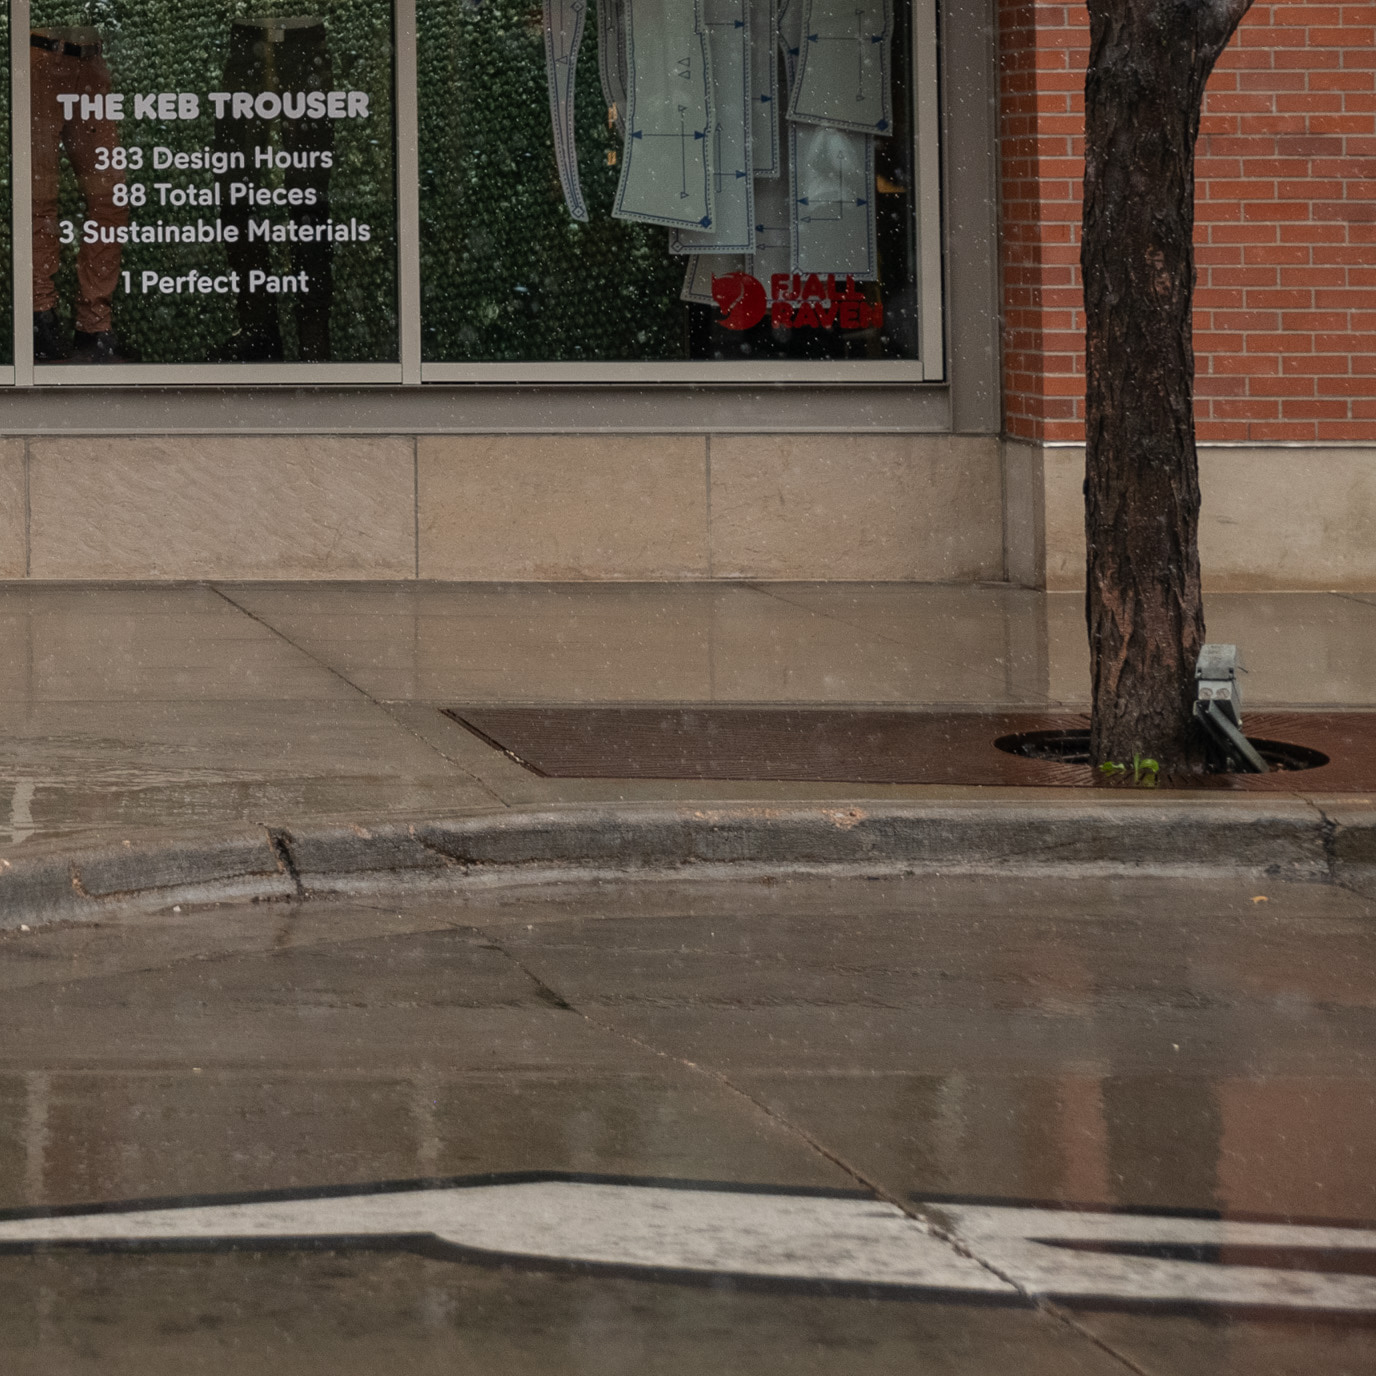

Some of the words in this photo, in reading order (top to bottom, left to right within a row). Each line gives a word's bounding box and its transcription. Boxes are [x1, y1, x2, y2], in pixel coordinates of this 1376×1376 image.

[56, 93, 125, 121] THE
[134, 93, 200, 120] KEB
[208, 91, 370, 119] TROUSER
[94, 146, 144, 171] 383
[152, 146, 245, 174] Design
[254, 146, 333, 169] Hours
[111, 183, 147, 207] 88
[153, 182, 220, 206] Total
[230, 182, 317, 206] Pieces
[58, 220, 75, 244] 3
[82, 219, 239, 244] Sustainable
[247, 218, 371, 243] Materials
[121, 271, 131, 294] 1
[141, 270, 240, 294] Perfect
[249, 270, 310, 293] Pant
